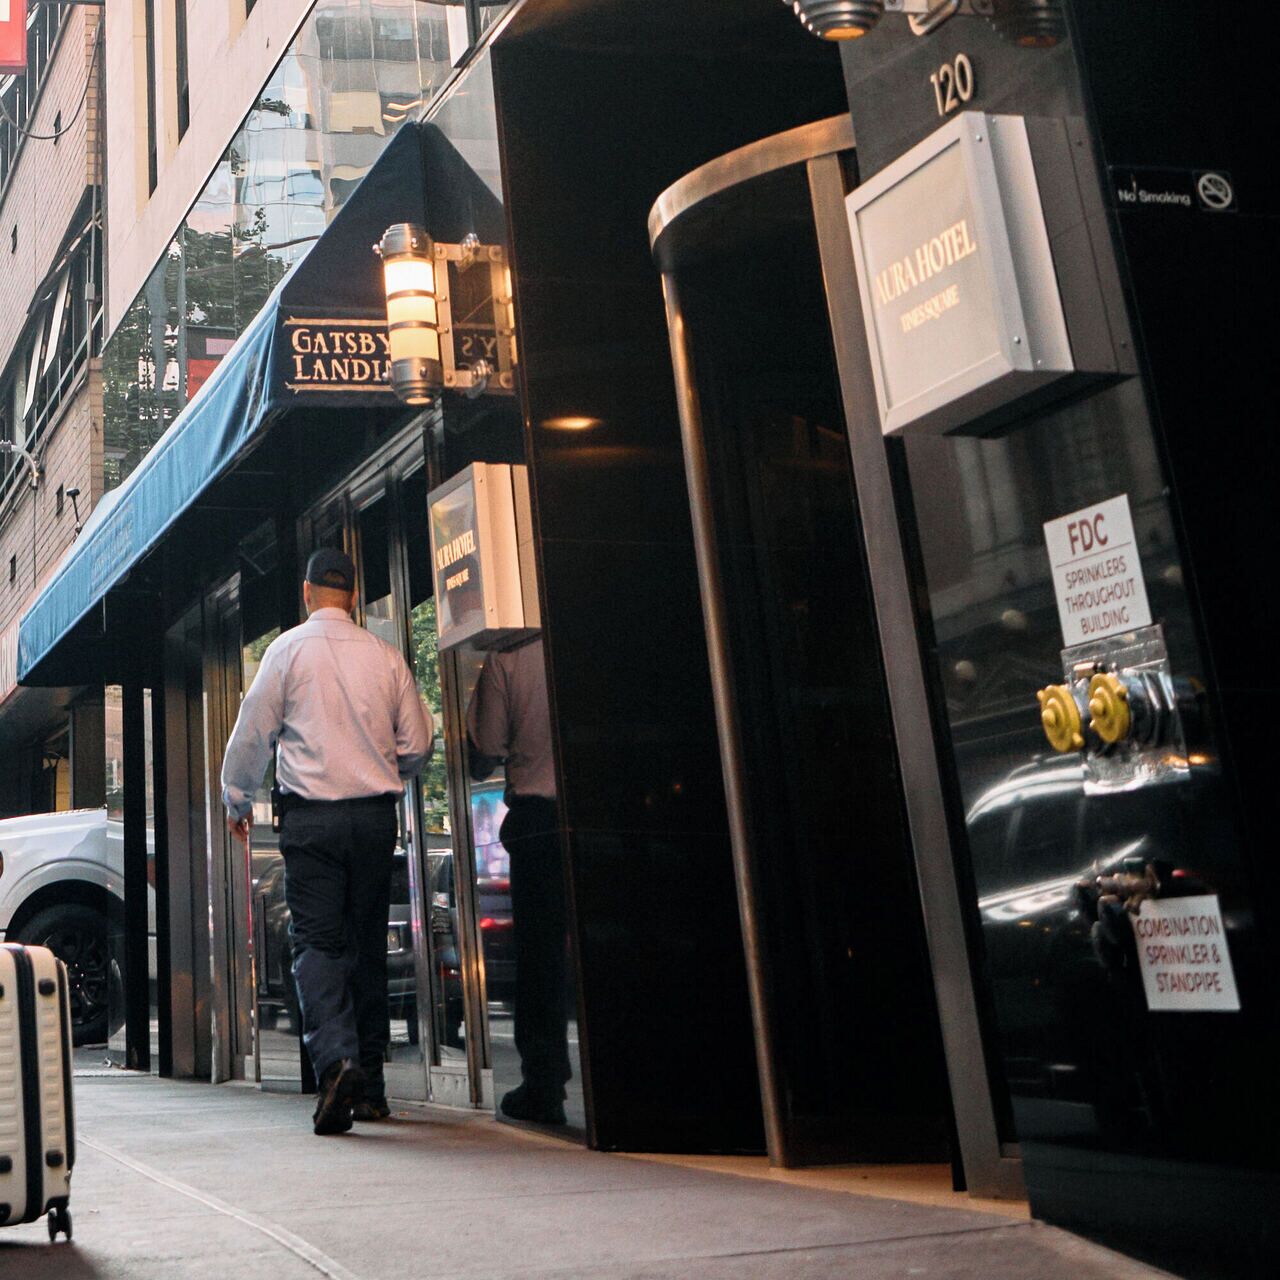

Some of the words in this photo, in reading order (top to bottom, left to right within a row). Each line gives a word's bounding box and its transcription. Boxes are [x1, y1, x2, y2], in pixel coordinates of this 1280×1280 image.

[930, 53, 973, 117] 120
[1118, 189, 1136, 201] No
[1139, 189, 1191, 206] Smoking
[915, 219, 977, 285] HOTEL
[291, 328, 390, 354] GATSBY
[293, 355, 391, 382] LANDI
[1067, 513, 1108, 555] FDC
[1065, 555, 1127, 589] SPRINKLERS
[1064, 578, 1136, 614] THROUGHOUT
[1080, 606, 1130, 634] BUILDING
[1136, 915, 1220, 938] COMBINATION
[1146, 944, 1209, 964] SPRINKLER
[1212, 943, 1221, 963] &
[1156, 972, 1222, 992] STANDPIPE
